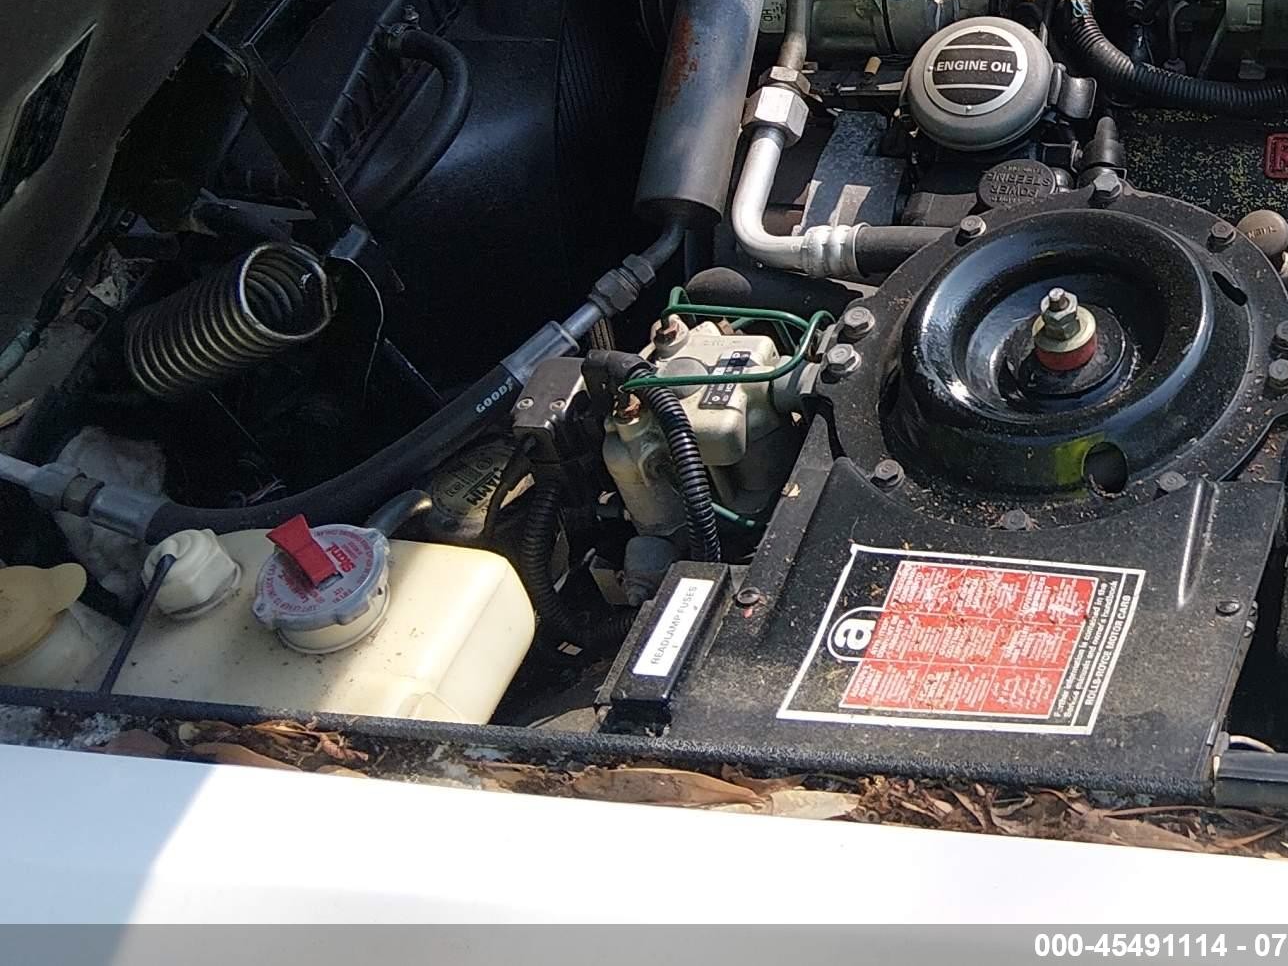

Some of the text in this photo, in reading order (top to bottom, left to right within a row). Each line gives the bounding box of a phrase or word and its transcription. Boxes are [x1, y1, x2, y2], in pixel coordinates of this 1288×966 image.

[936, 60, 1014, 73] ENGINE OIL
[650, 586, 697, 664] HEADLAMP FUSES
[1086, 645, 1095, 657] and
[1100, 581, 1118, 615] handbook
[1096, 583, 1106, 594] the
[1084, 595, 1131, 705] ROLLS-ROYCE MOTOR CARS
